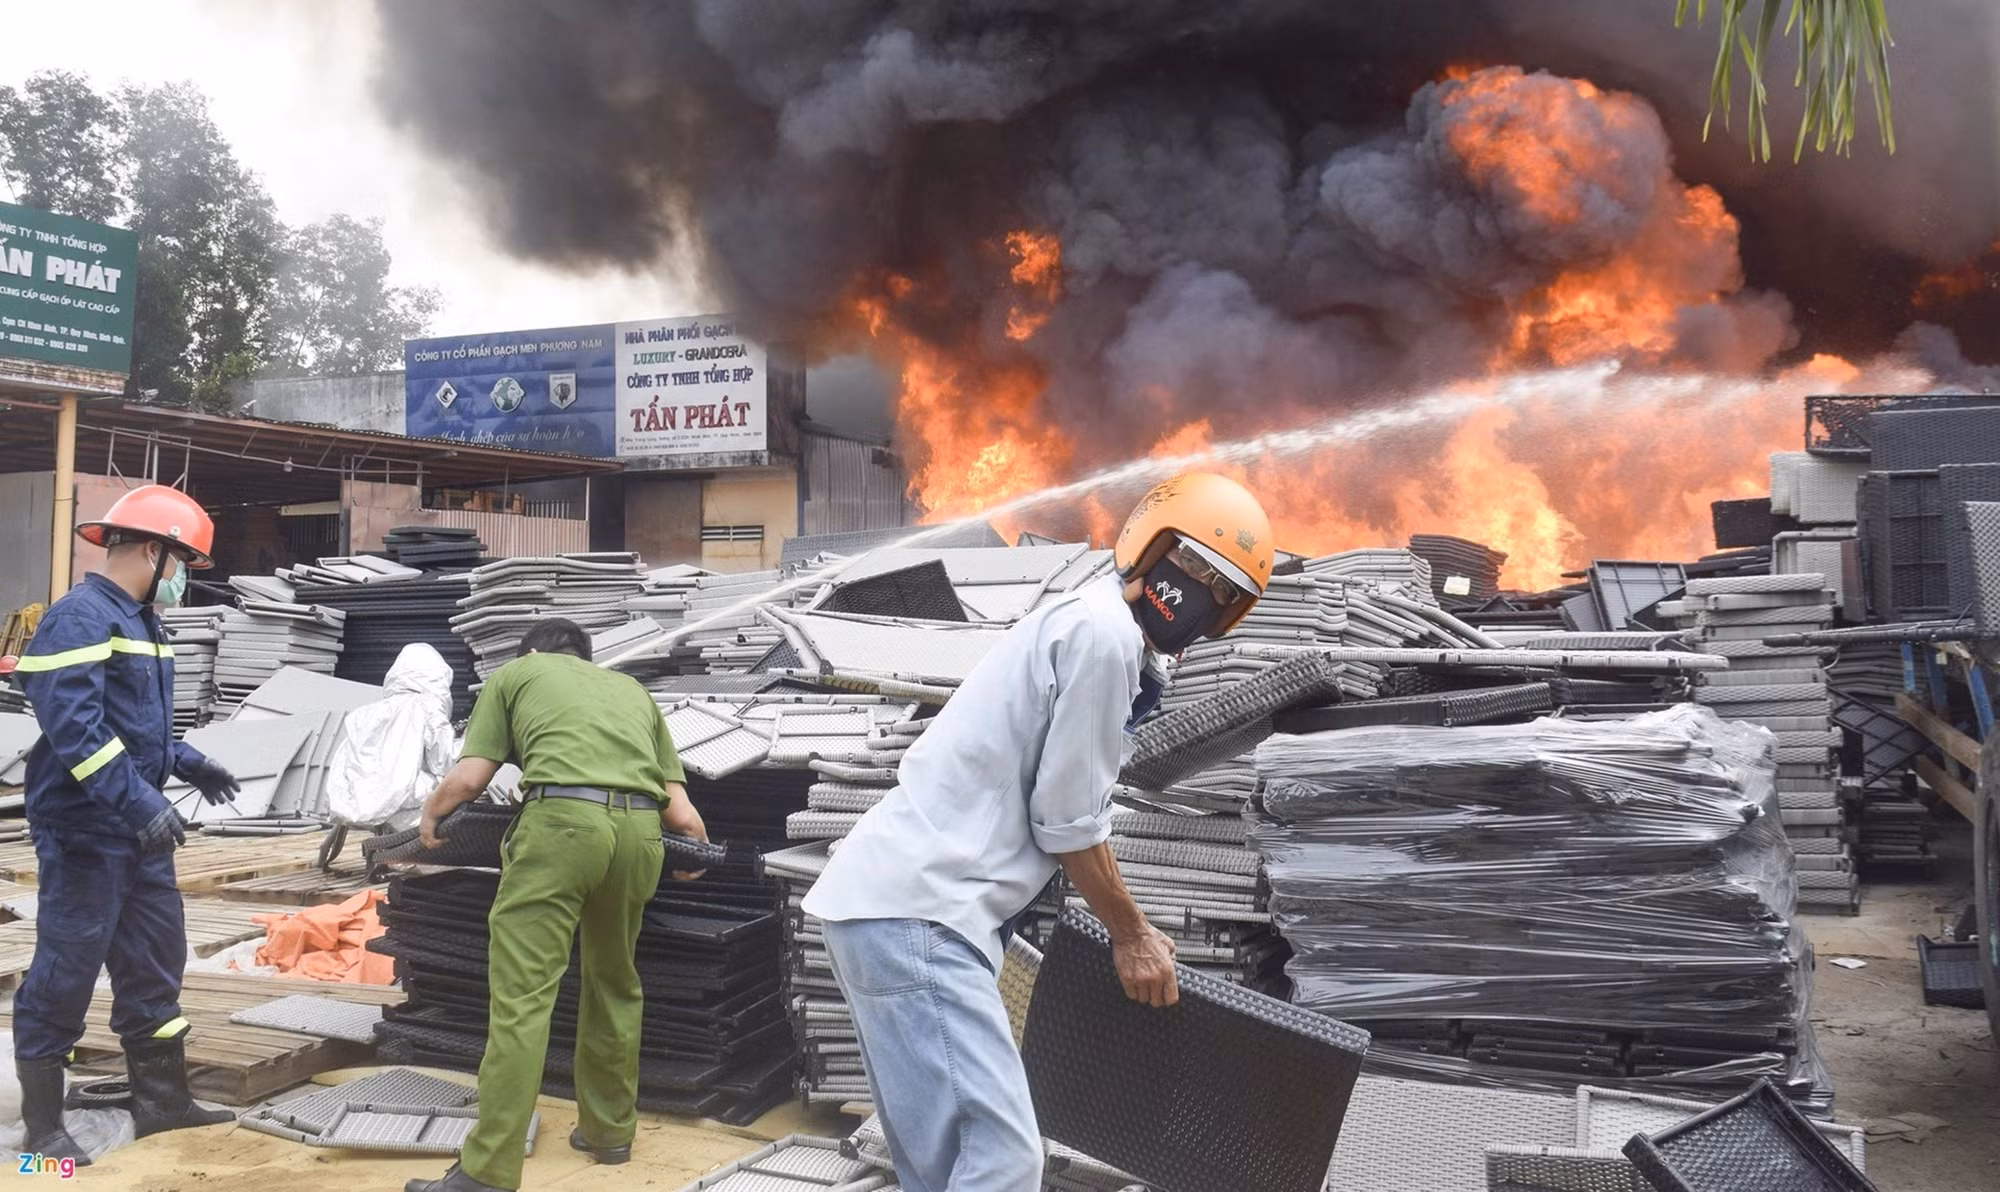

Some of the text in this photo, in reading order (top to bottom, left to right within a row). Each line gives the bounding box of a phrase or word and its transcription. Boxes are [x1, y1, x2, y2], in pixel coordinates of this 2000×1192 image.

[0, 222, 108, 254] NG TY TNHH TỔNG HỢP
[46, 255, 121, 293] PHÁT
[0, 285, 20, 297] CUNG
[21, 288, 39, 300] CẤP
[39, 293, 60, 304] GẠCH
[72, 299, 88, 309] LÁT
[87, 302, 104, 312] CAO
[104, 304, 121, 314] CẤP
[625, 327, 645, 345] NHÀ
[648, 326, 674, 343] PHÂN
[677, 321, 700, 340] PHỐI
[414, 349, 439, 363] CÔNG
[442, 350, 451, 360] TY
[453, 343, 467, 359] CỔ
[493, 345, 518, 358] GẠCH
[520, 343, 538, 354] MEN
[581, 338, 603, 350] NAM
[633, 350, 677, 366] LUXURY
[626, 362, 754, 389] CÔNG TY TNHH TỔNG HỢP
[629, 394, 751, 432] TẤN PHÁT
[562, 424, 585, 440] ho
[1144, 585, 1175, 621] MANGO
